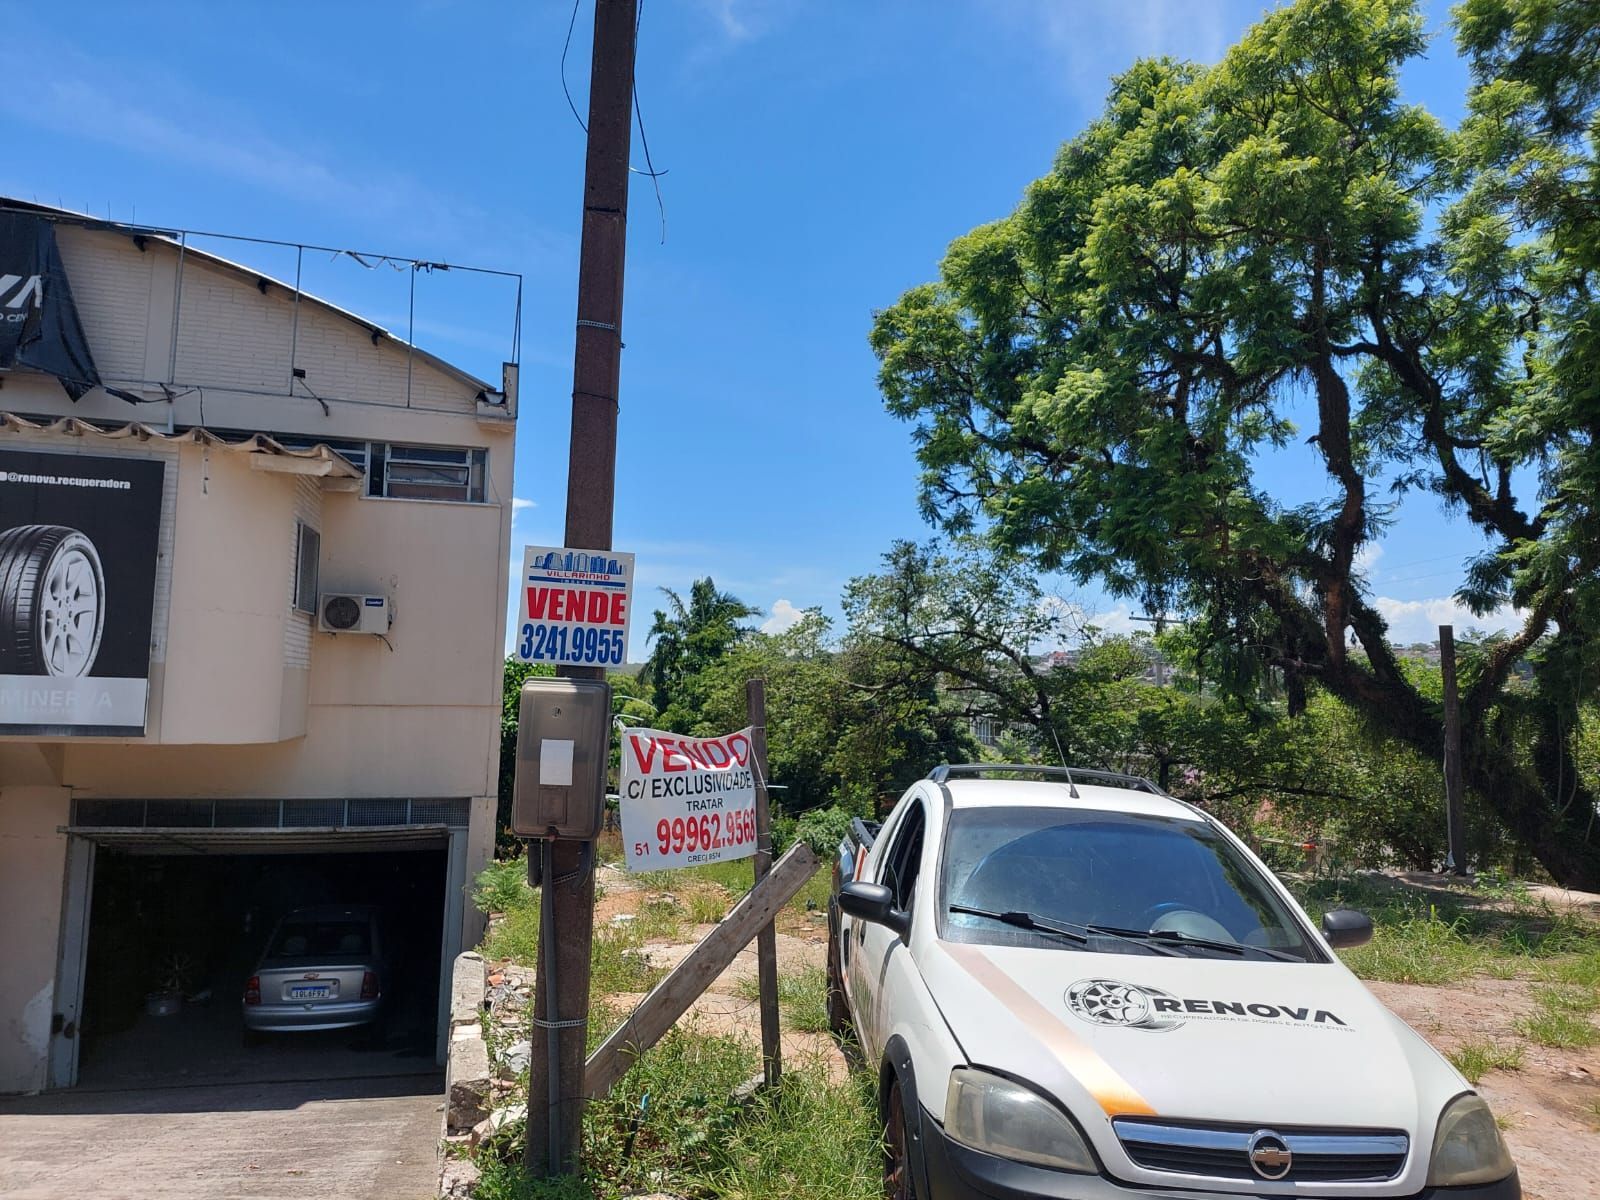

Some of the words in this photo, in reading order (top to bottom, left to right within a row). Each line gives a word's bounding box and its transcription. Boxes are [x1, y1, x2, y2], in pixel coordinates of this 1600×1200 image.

[7, 472, 131, 489] @renova.recuperadora
[546, 570, 611, 581] VILLARINHO
[527, 587, 627, 625] VENDE
[520, 623, 624, 665] 3241.9955
[629, 734, 750, 775] VENDO
[627, 780, 646, 799] C/
[651, 770, 753, 798] EXCLUSIVIDADE
[686, 797, 724, 812] TRATAR
[635, 842, 650, 856] 51
[656, 808, 756, 855] 99962.9568
[1152, 998, 1347, 1026] RENOVA
